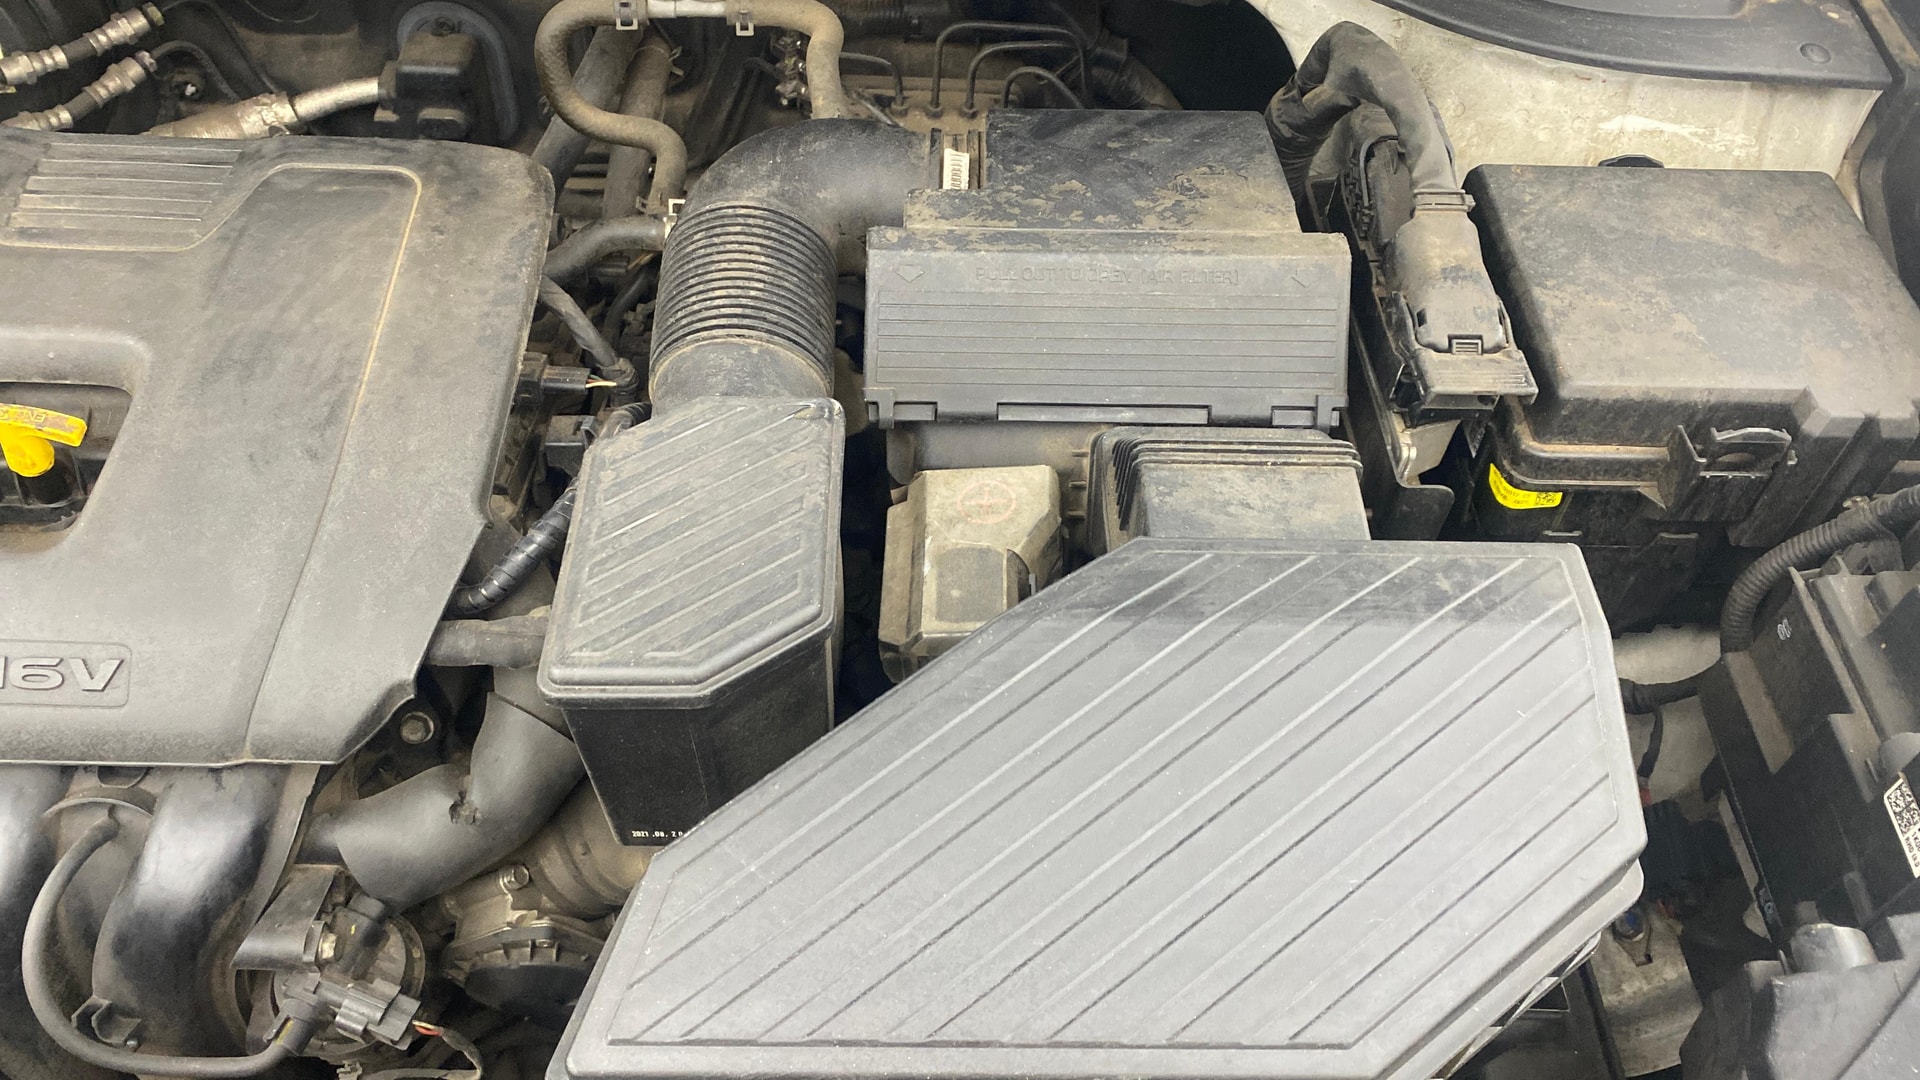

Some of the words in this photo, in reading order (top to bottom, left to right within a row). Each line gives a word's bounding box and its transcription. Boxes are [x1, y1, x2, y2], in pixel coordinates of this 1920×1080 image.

[976, 266, 1017, 281] PULL
[1022, 266, 1056, 281] OUT
[1059, 267, 1082, 281] TO
[1087, 266, 1132, 284] OPEN
